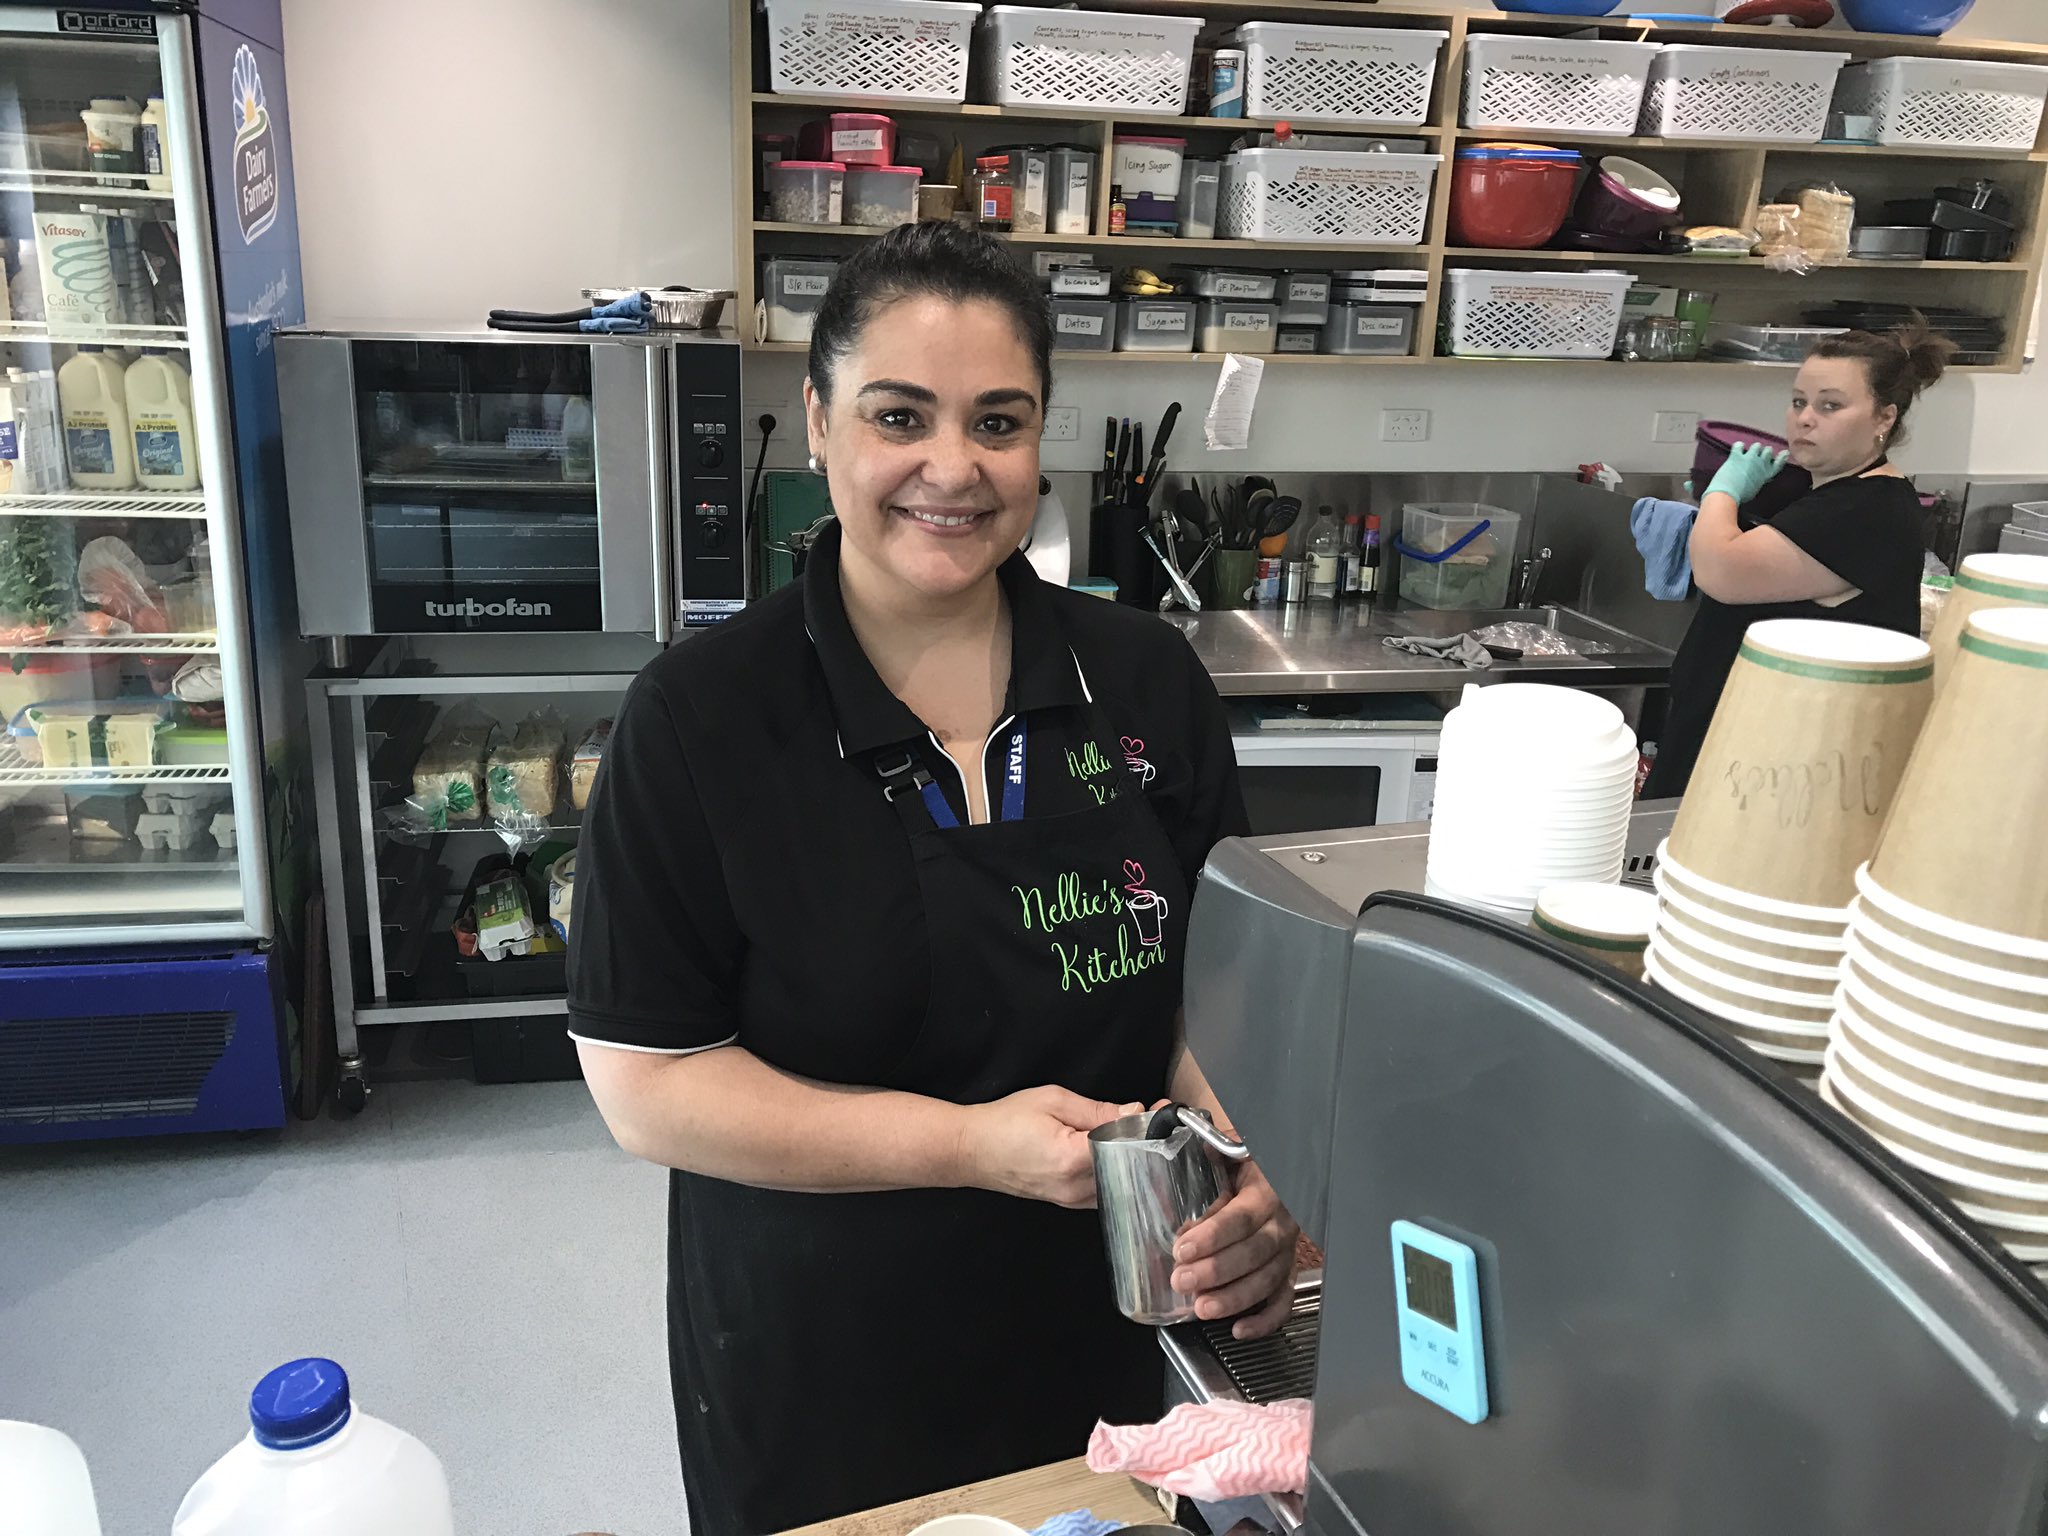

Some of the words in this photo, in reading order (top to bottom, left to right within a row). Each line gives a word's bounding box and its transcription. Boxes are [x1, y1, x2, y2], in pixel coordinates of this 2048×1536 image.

[245, 144, 266, 182] Dairy
[1124, 156, 1146, 173] Icing
[1148, 160, 1172, 172] Sugar
[243, 173, 274, 216] Farmers
[41, 223, 87, 238] Vitasoy
[47, 292, 80, 307] Café
[1064, 317, 1092, 329] Dates
[1229, 315, 1246, 328] Raw
[1248, 314, 1267, 331] Sugar
[78, 421, 108, 429] Protein
[425, 598, 551, 616] turbofan
[1008, 734, 1023, 785] STAFF
[1011, 871, 1125, 933] Nellie's
[1051, 923, 1166, 993] Kitchen
[1420, 1369, 1450, 1393] ACCURA
